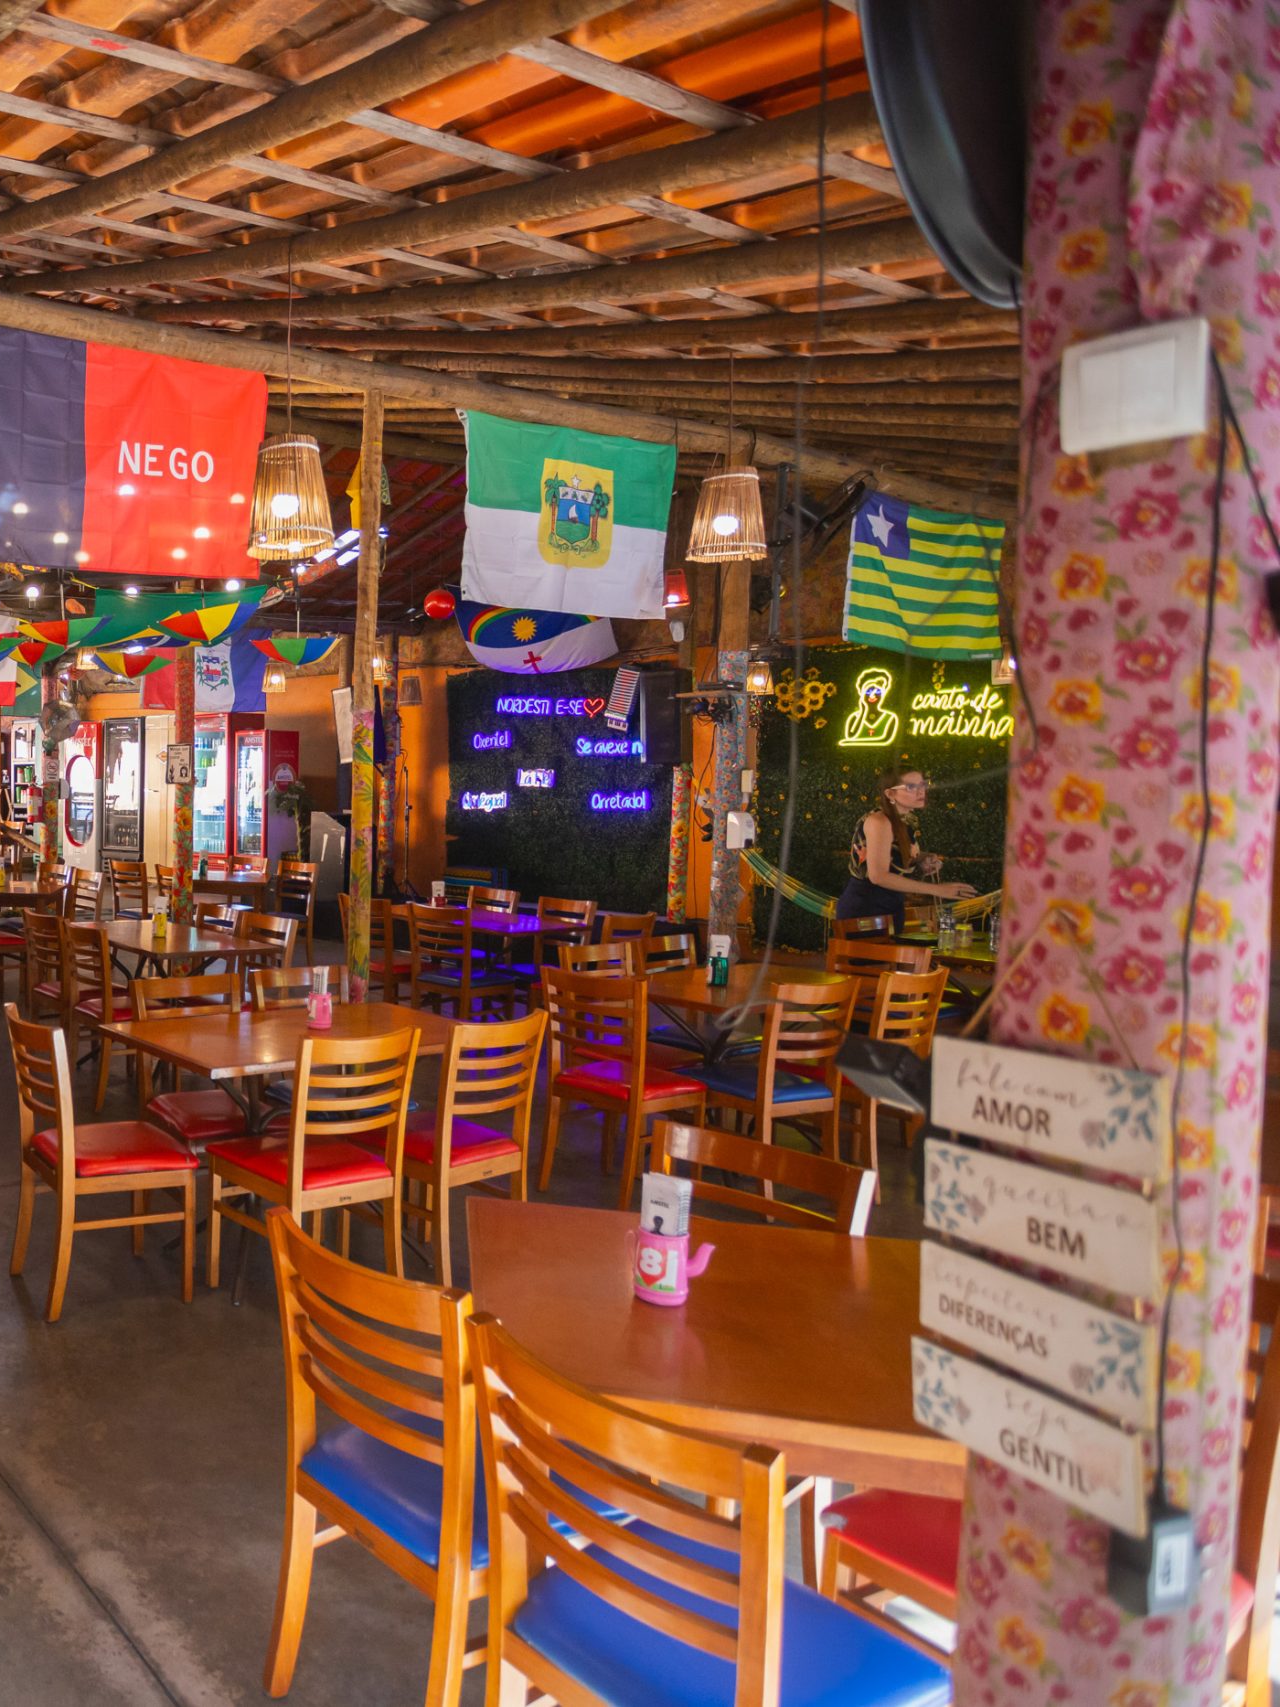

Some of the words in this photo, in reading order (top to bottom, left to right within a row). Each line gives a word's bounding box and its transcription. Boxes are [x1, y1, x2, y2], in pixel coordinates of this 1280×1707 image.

[118, 440, 214, 483] NEGO
[912, 687, 967, 710] canto
[970, 685, 1004, 711] de
[910, 709, 1015, 740] mainha
[972, 1095, 1052, 1137] AMOR
[1026, 1215, 1087, 1260] BEM
[937, 1292, 1049, 1358] DIFERENÇAS
[998, 1427, 1090, 1498] GENTIL
